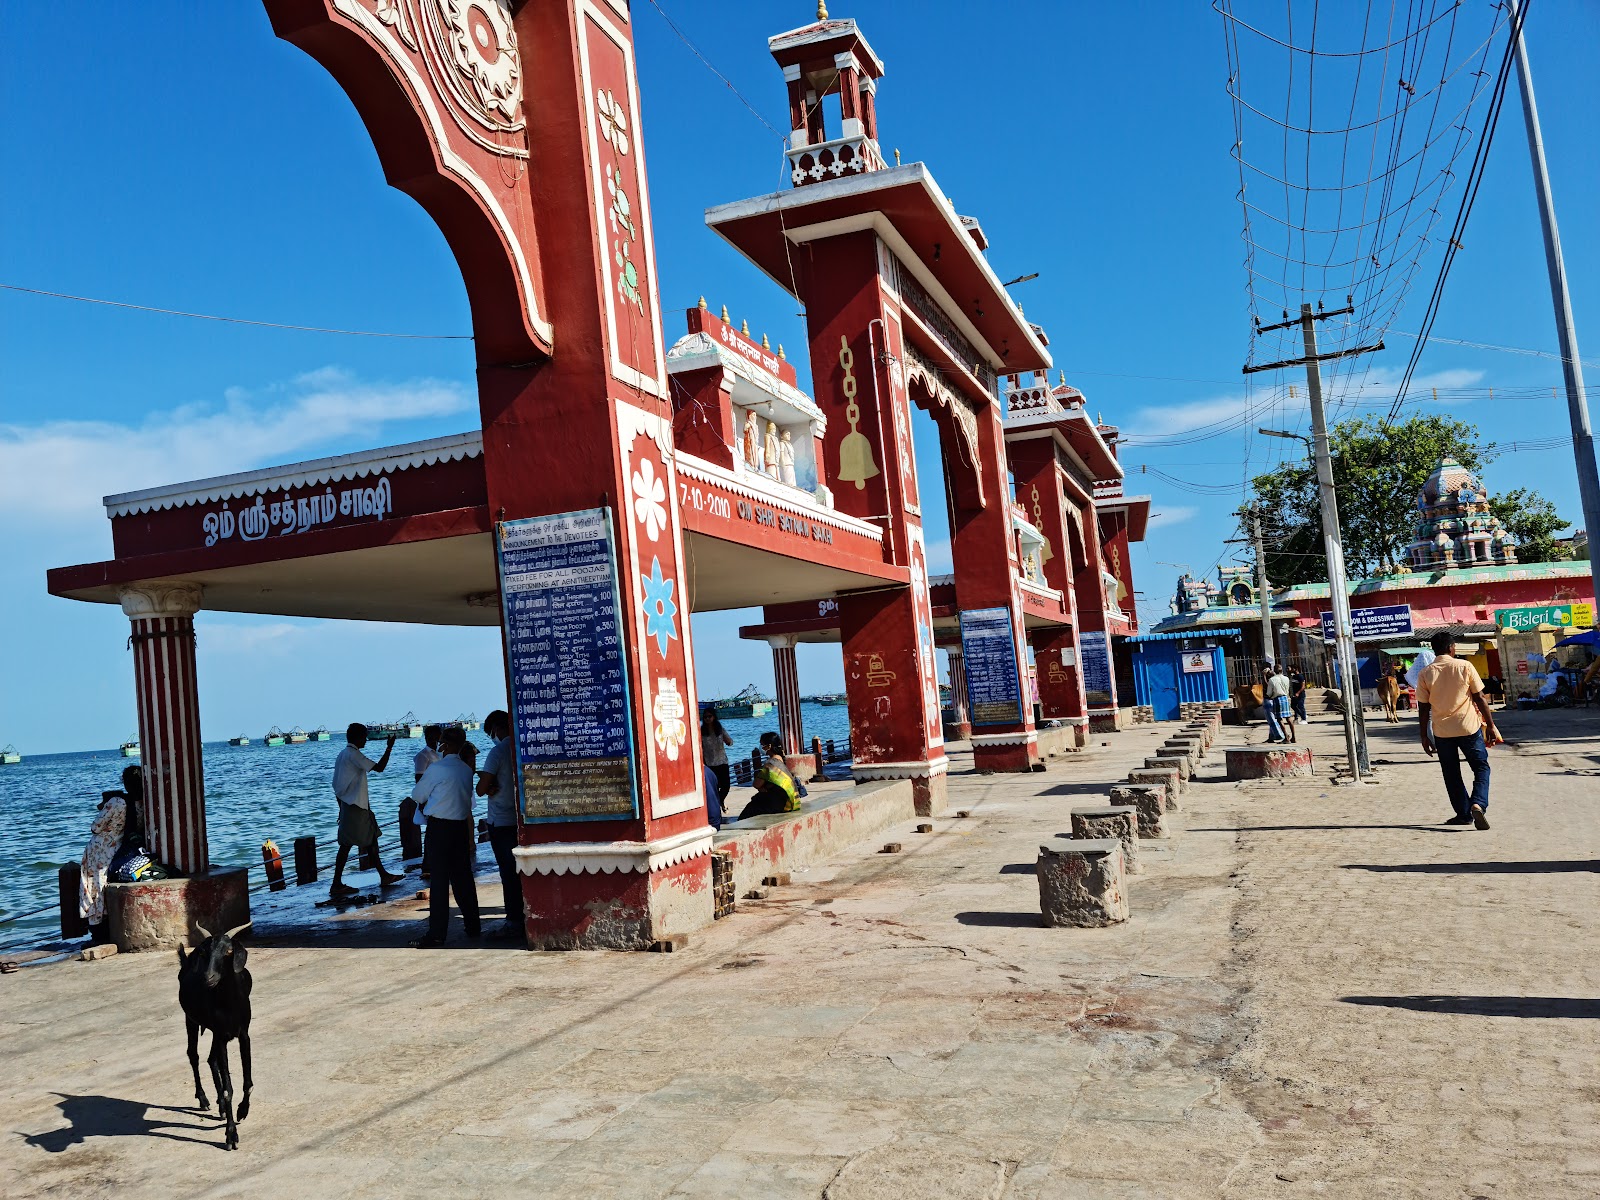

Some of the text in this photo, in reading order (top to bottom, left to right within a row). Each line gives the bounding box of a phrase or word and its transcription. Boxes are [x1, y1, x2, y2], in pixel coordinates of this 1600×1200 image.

[737, 500, 833, 545] OM SHRI SATNAM SAKHI
[504, 529, 598, 549] ANNOUNCEMENT TO THE DEVOTEES
[506, 575, 524, 583] FIXED
[539, 571, 552, 579] FOR
[554, 569, 569, 577] ALL
[571, 565, 605, 575] POOJAS
[507, 581, 549, 592] PERFORMING
[600, 591, 611, 600] 100
[1367, 614, 1393, 623] DRESSING
[1395, 612, 1409, 620] ROOM
[1509, 610, 1549, 628] Bisleri
[608, 669, 620, 678] 750
[610, 684, 621, 693] 750
[610, 699, 623, 708] 750
[519, 719, 524, 727] 9
